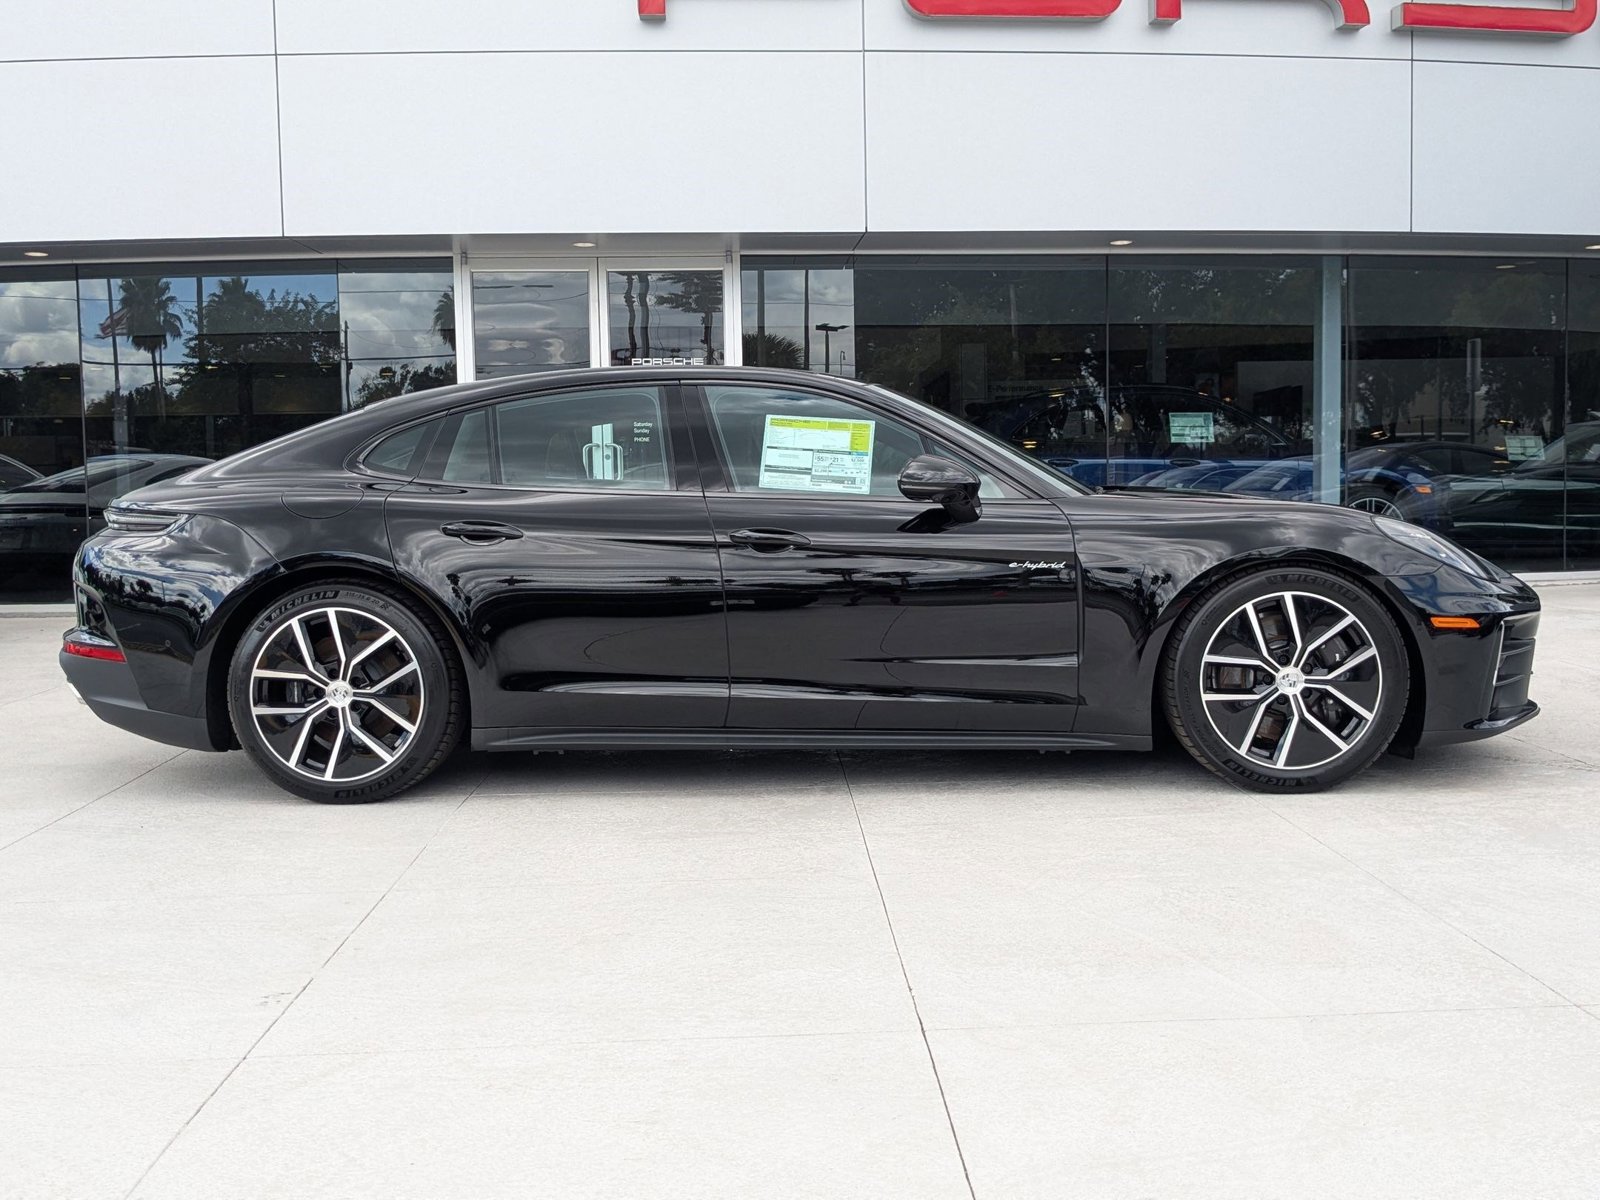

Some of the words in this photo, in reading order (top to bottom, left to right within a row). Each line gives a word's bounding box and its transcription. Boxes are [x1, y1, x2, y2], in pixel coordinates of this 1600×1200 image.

[631, 357, 705, 366] PORSCHE
[1008, 560, 1066, 570] e-hybrid
[1286, 574, 1358, 602] MICHELIN
[270, 590, 336, 620] MICHELIN
[1226, 761, 1297, 786] MICHELIN
